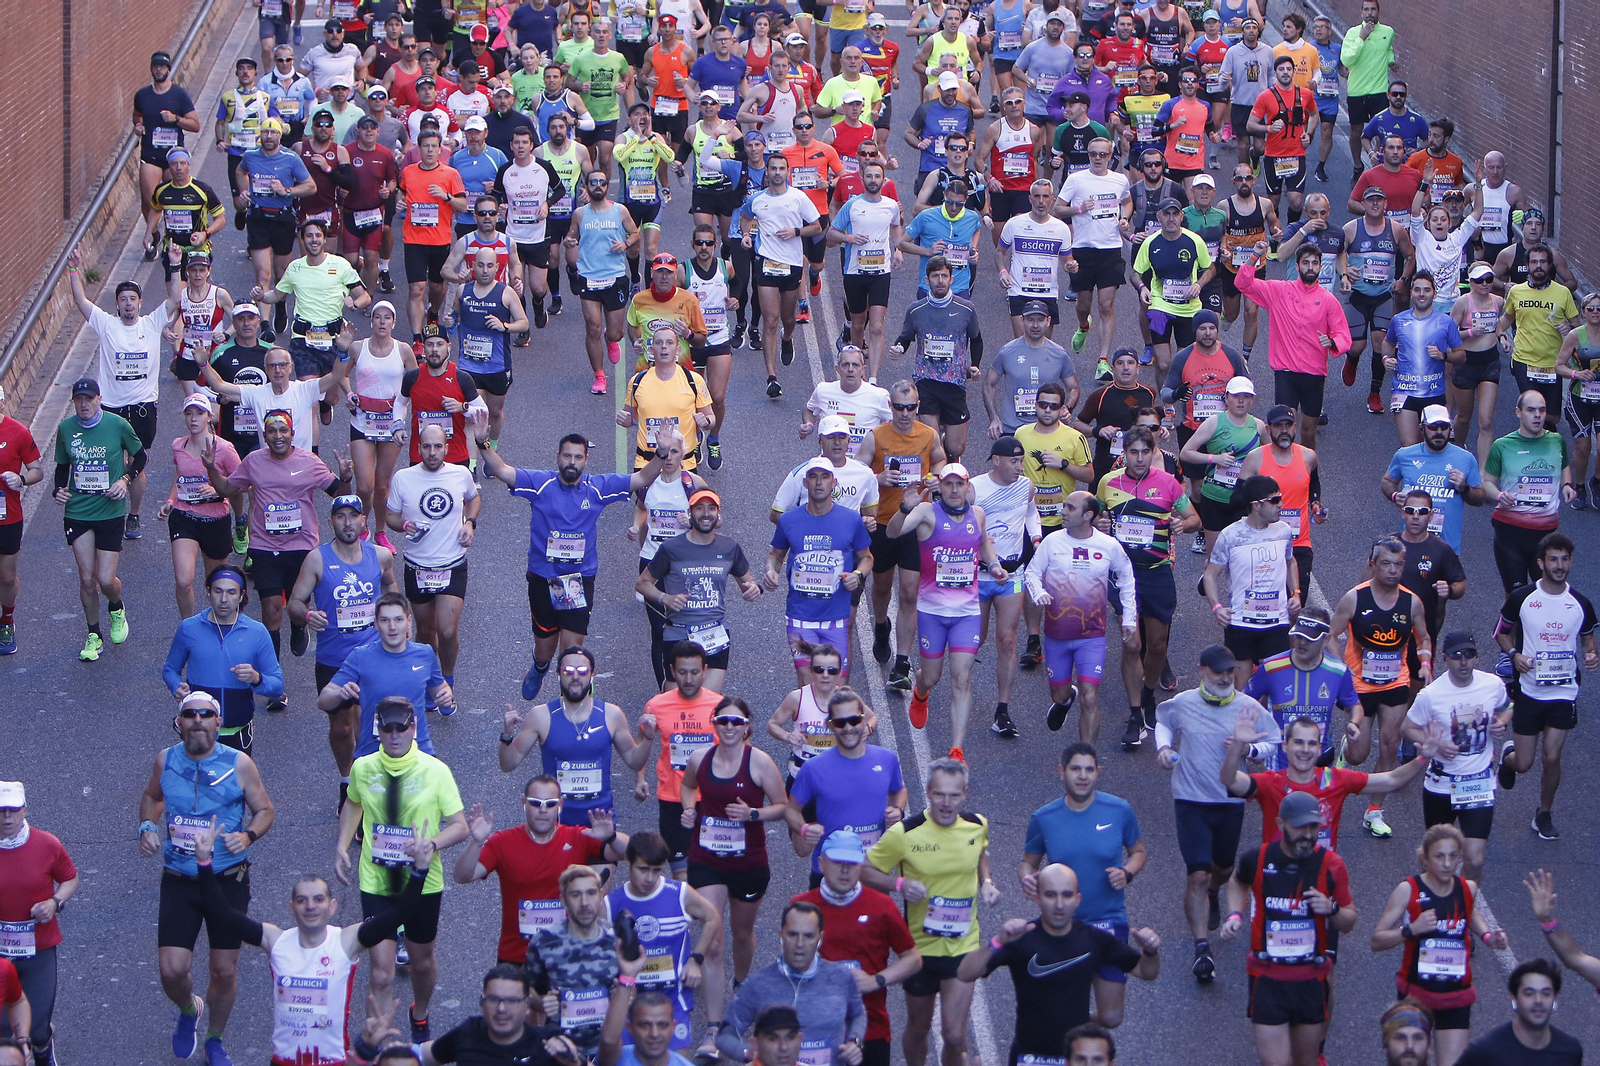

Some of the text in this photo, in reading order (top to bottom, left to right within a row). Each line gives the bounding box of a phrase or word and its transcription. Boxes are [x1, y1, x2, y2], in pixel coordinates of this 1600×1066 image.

[1021, 240, 1055, 252] asdent
[1518, 300, 1556, 310] REDOLAT
[185, 315, 210, 326] BEV
[1417, 474, 1446, 487] 42K
[699, 577, 714, 585] SAL
[704, 583, 713, 591] VA
[699, 622, 719, 630] ZURICH
[1546, 620, 1563, 630] edp
[1372, 628, 1398, 641] aodi
[183, 819, 210, 827] ZURICH
[385, 827, 412, 836] ZURICH
[854, 824, 878, 833] ZURICH
[384, 842, 402, 850] 7287
[292, 977, 322, 988] ZURICH
[575, 990, 603, 999] ZURICH
[291, 995, 312, 1004] 7282
[280, 1020, 308, 1029] SEVILLA
[799, 1040, 825, 1049] URICH
